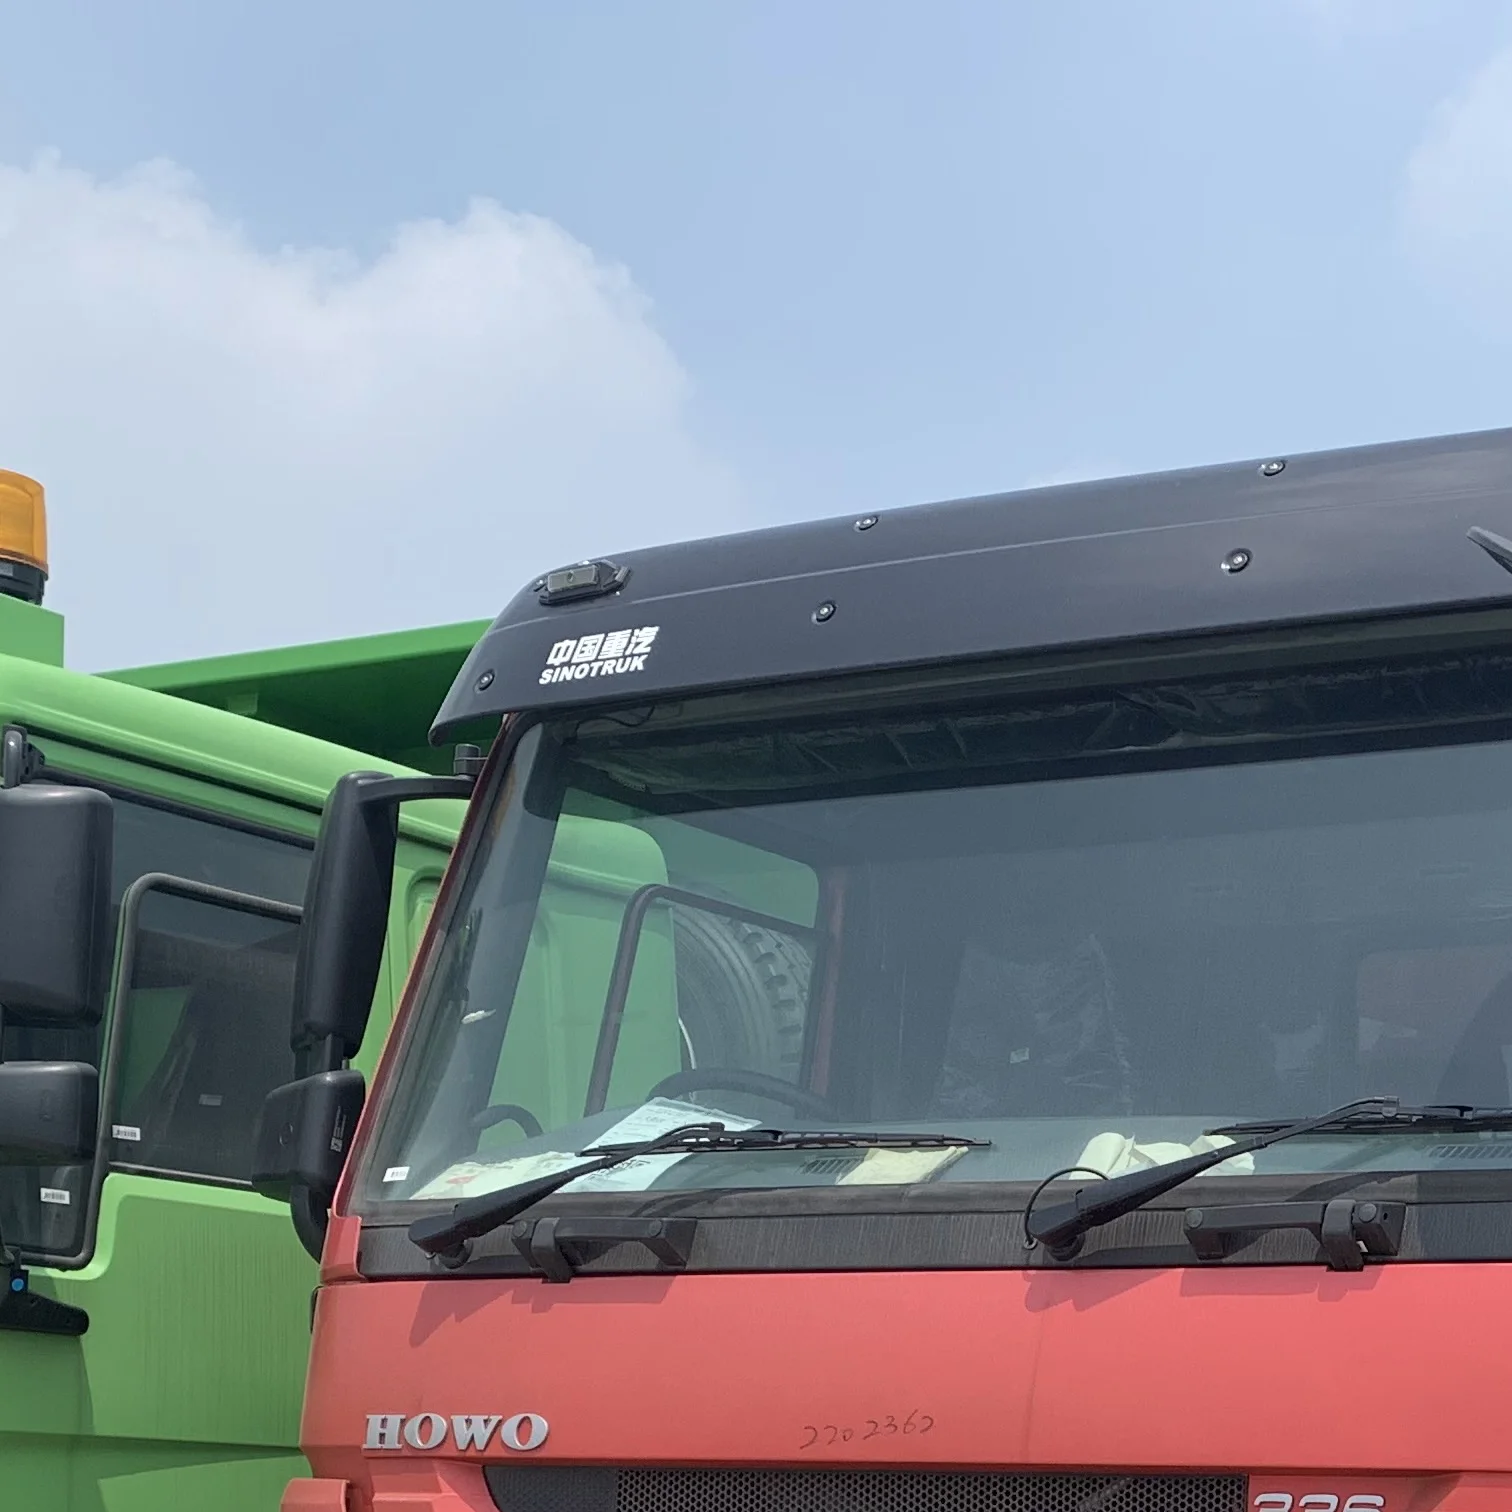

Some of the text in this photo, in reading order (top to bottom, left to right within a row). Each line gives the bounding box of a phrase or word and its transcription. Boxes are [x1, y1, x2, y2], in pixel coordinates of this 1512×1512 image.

[546, 626, 660, 666] 中国重汽
[539, 654, 649, 684] SINOTRUK
[362, 1412, 549, 1451] HOWO
